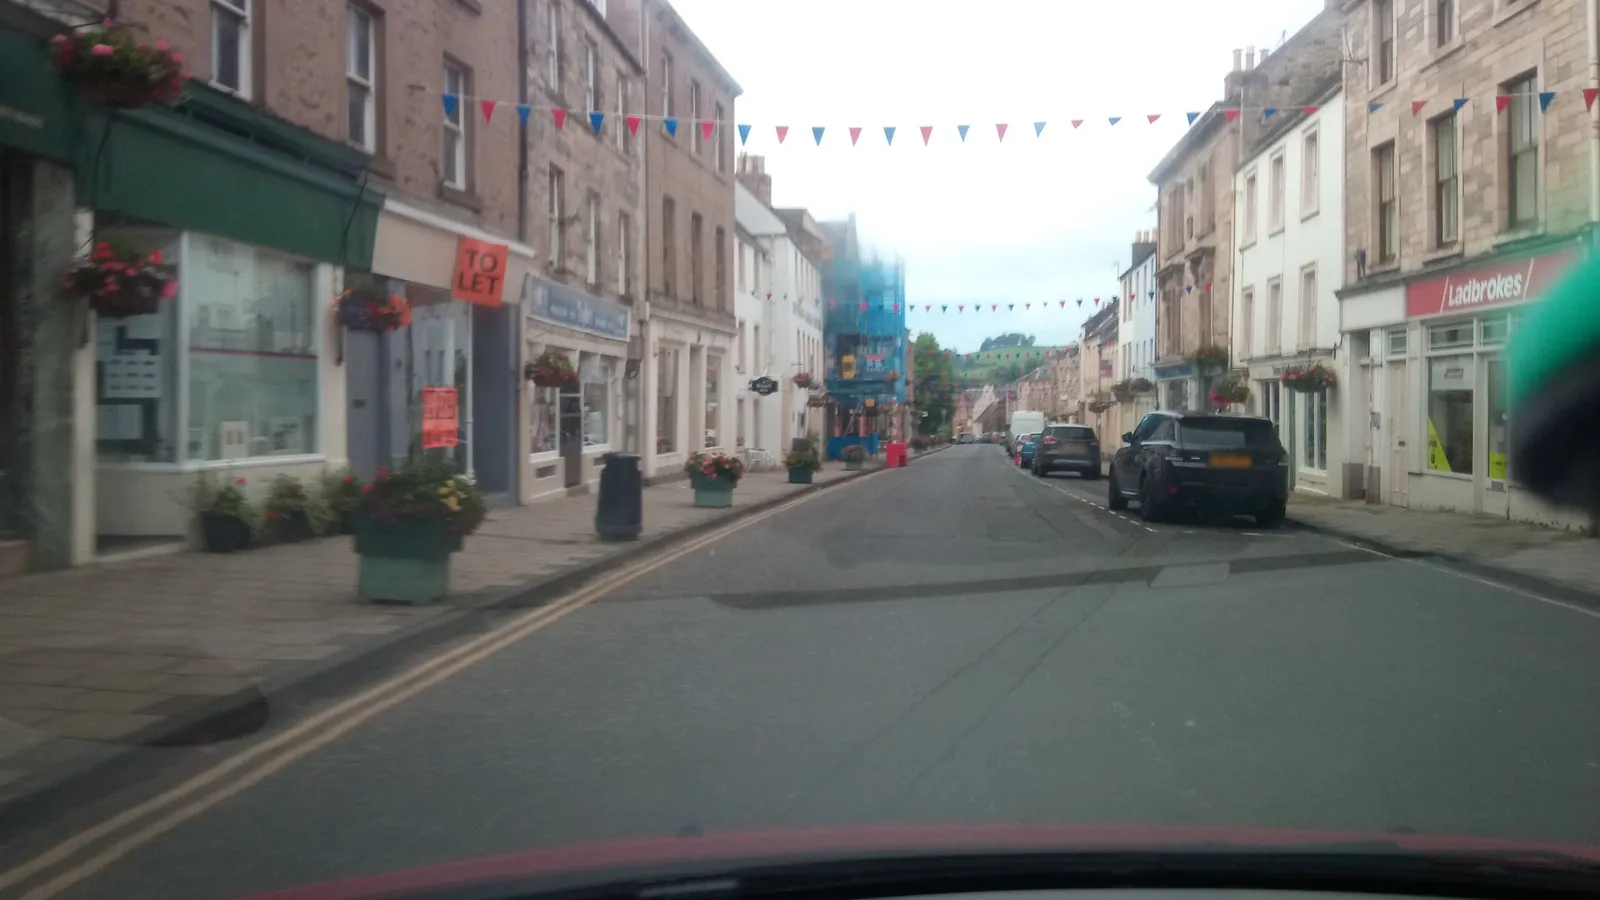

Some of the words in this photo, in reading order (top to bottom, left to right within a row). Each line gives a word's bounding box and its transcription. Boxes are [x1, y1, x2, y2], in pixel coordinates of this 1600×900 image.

[465, 249, 498, 273] TO
[459, 272, 500, 295] LET
[1449, 273, 1522, 307] Ladbrokes
